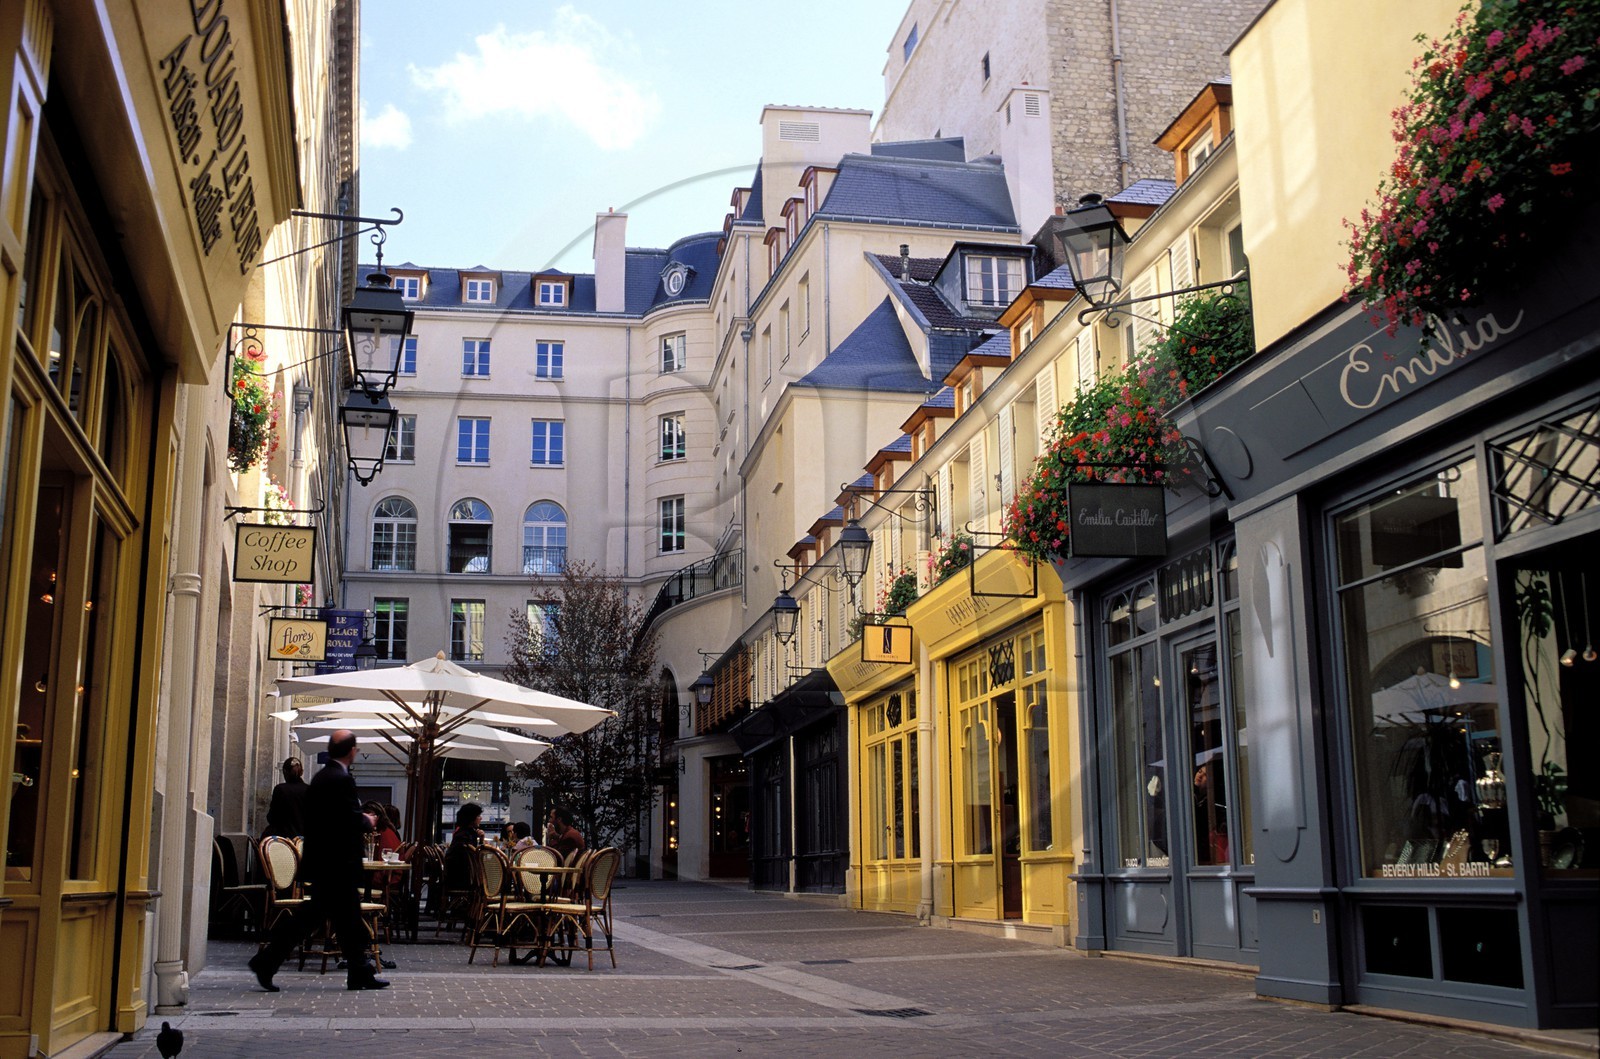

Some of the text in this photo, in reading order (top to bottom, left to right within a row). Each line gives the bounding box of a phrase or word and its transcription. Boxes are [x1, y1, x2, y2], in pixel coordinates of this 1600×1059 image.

[159, 34, 202, 164] Artisan
[190, 149, 224, 257] Joaillier
[189, 0, 262, 276] DOUARD LE JEUNE
[1339, 308, 1524, 410] Emilia
[1079, 507, 1158, 527] Emilia Castillo
[245, 531, 307, 552] Coffee
[250, 555, 298, 576] Shop
[336, 616, 347, 624] LE
[327, 639, 353, 648] ROYAL
[1382, 863, 1416, 877] BEVERLY
[1418, 862, 1440, 877] HILLS
[1446, 862, 1458, 877] St.
[1459, 861, 1490, 877] BARTH
